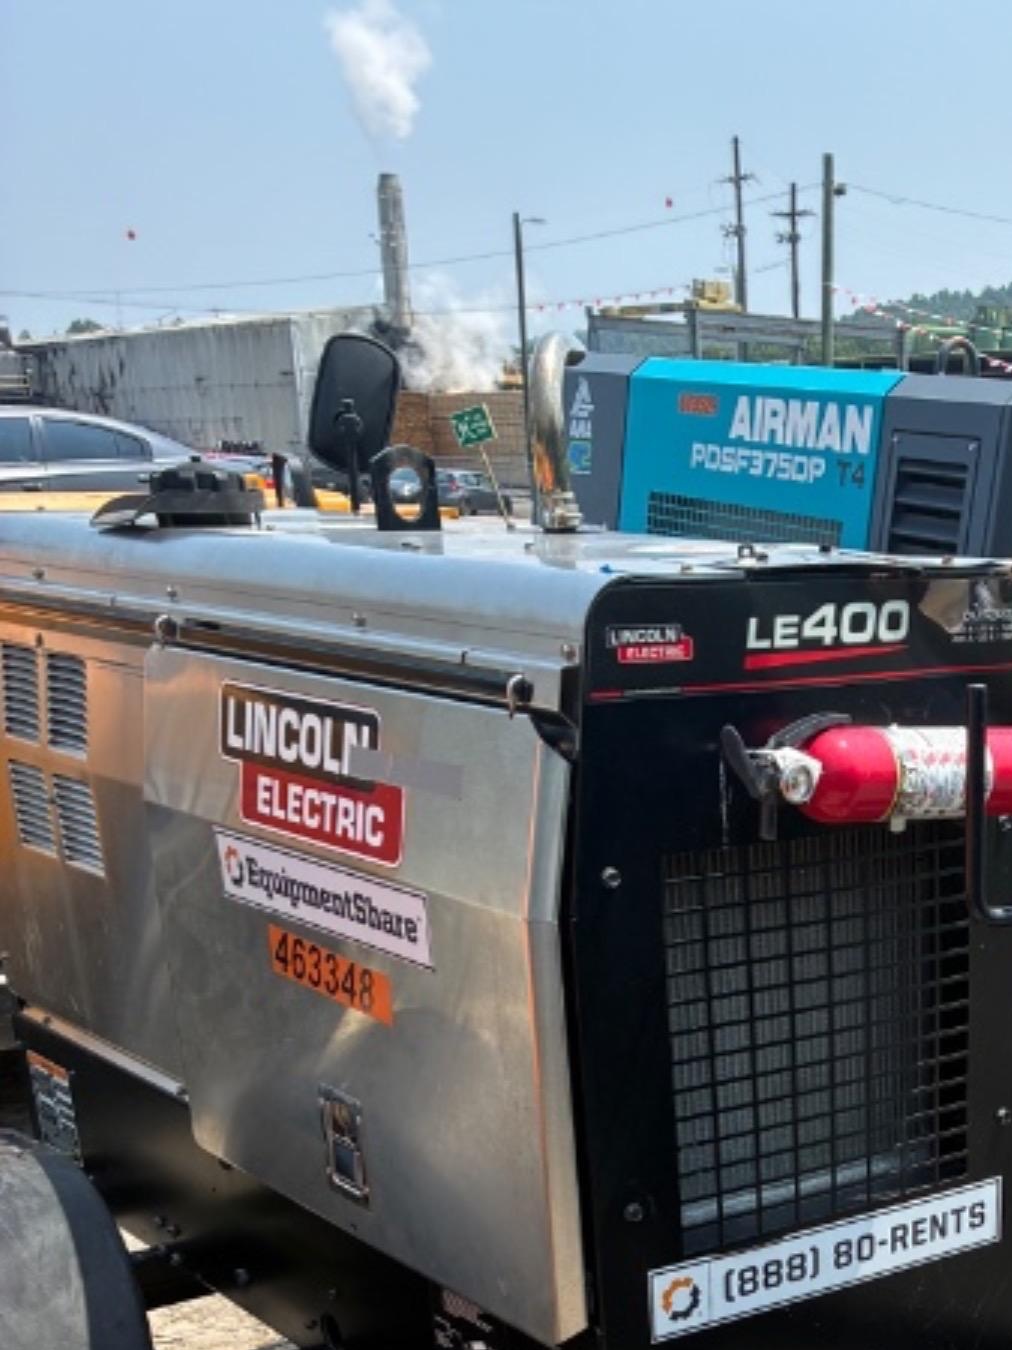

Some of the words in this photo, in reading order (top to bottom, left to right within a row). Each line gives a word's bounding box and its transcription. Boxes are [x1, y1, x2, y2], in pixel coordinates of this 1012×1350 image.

[729, 396, 873, 454] AIRMAN
[837, 460, 865, 488] T4
[610, 628, 679, 645] LINCOLN
[626, 645, 686, 660] ELECTRIC
[746, 600, 910, 649] LE400
[257, 774, 385, 848] ELECTRIC
[245, 856, 419, 944] EquipmentShare
[275, 932, 375, 1010] 463348
[724, 1246, 821, 1302] (888)
[833, 1201, 986, 1270] 80-RENTS
